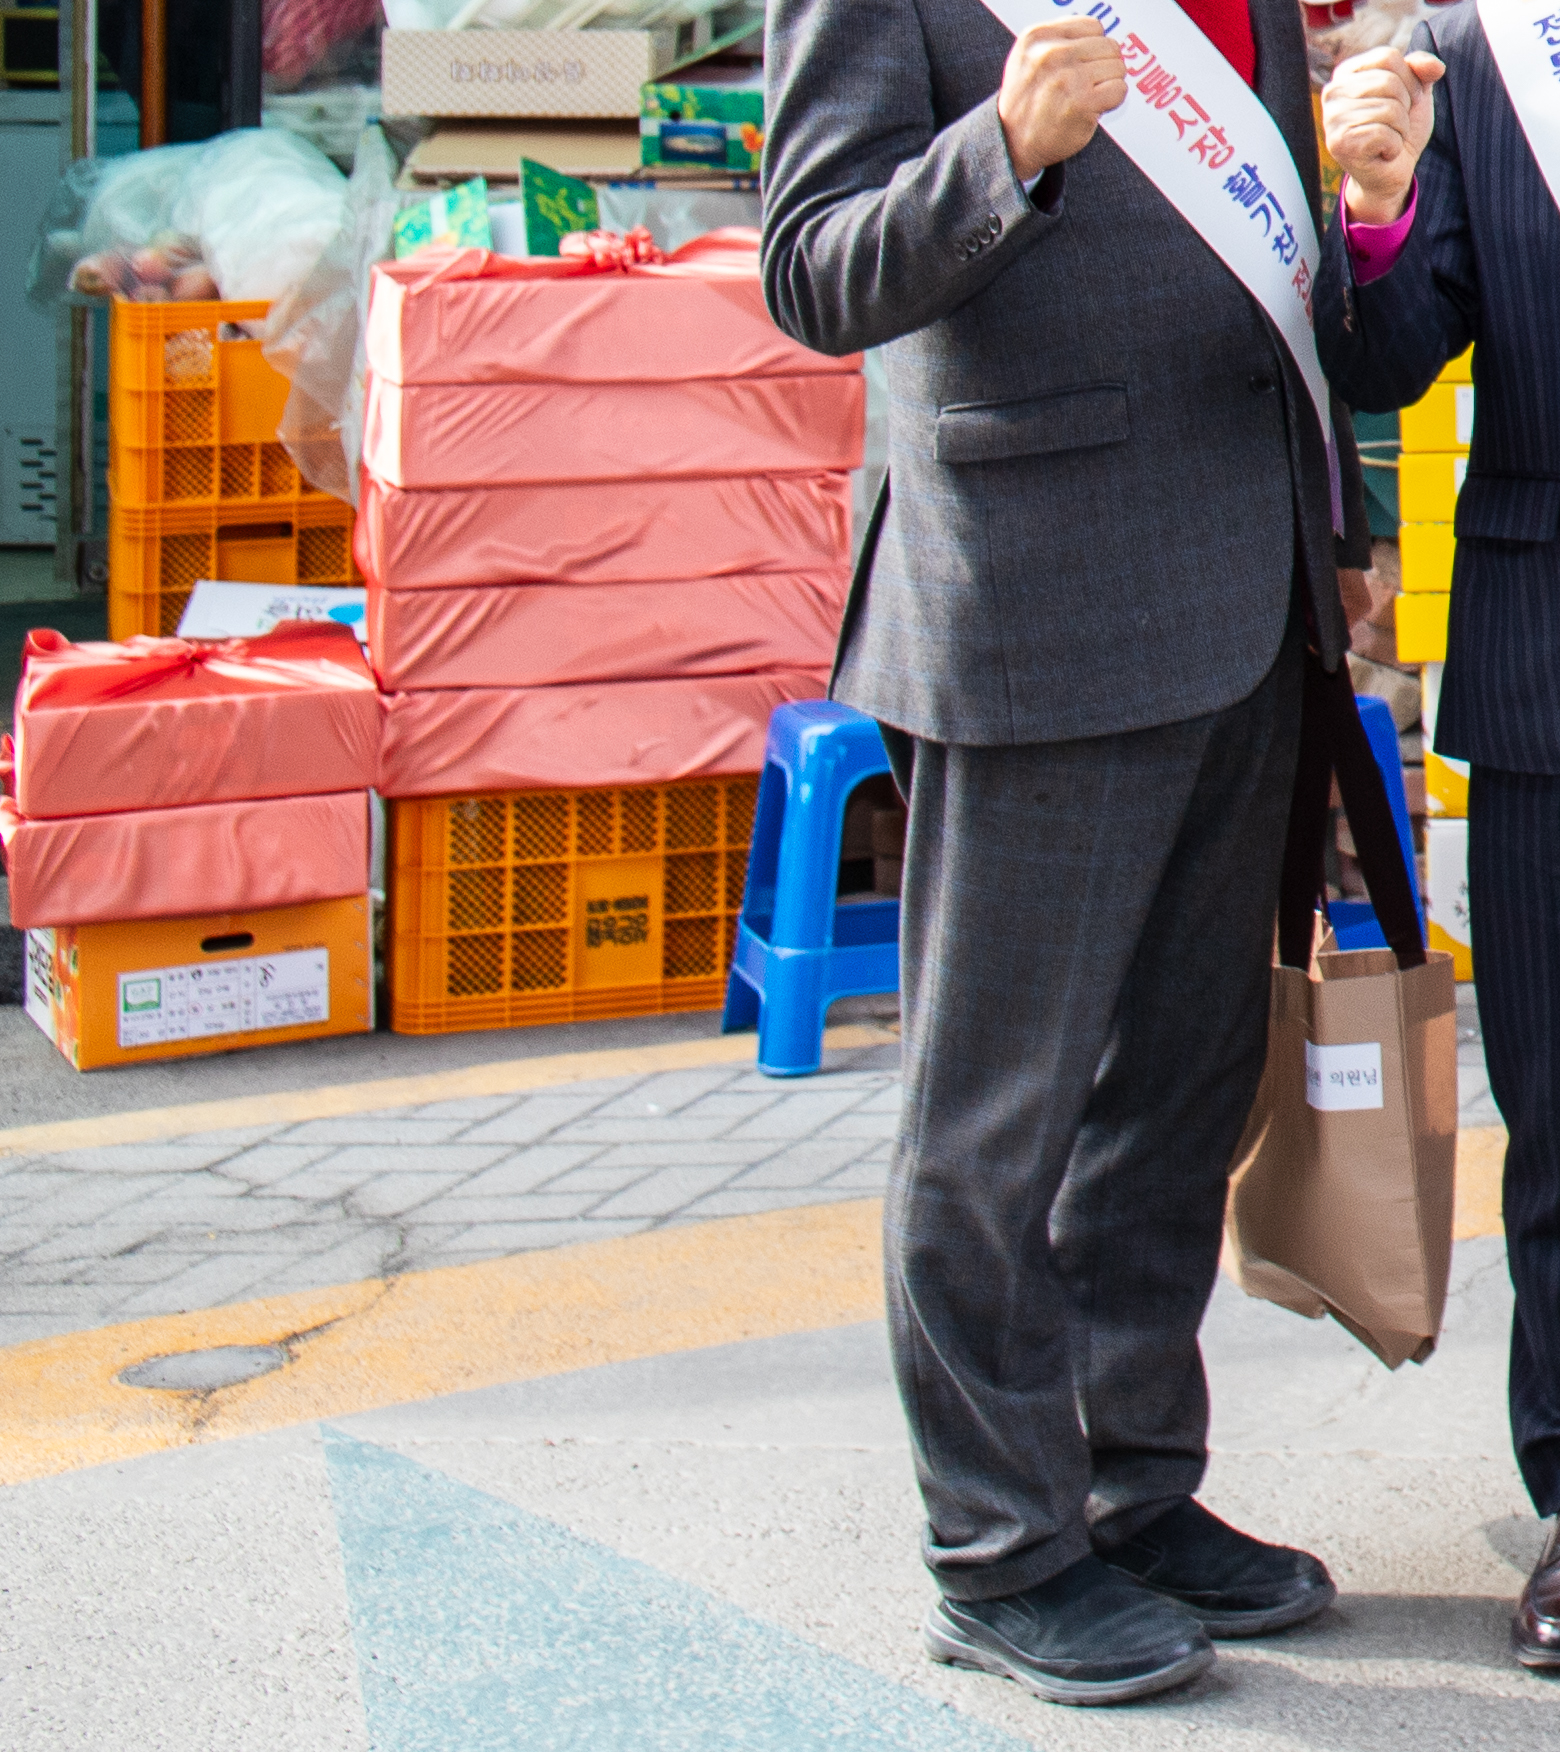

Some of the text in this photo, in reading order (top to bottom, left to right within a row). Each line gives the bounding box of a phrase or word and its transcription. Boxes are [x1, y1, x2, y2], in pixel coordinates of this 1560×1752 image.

[1119, 33, 1236, 171] 전통시장
[1222, 162, 1299, 266] 활기찬
[1328, 1067, 1378, 1087] 의원님
